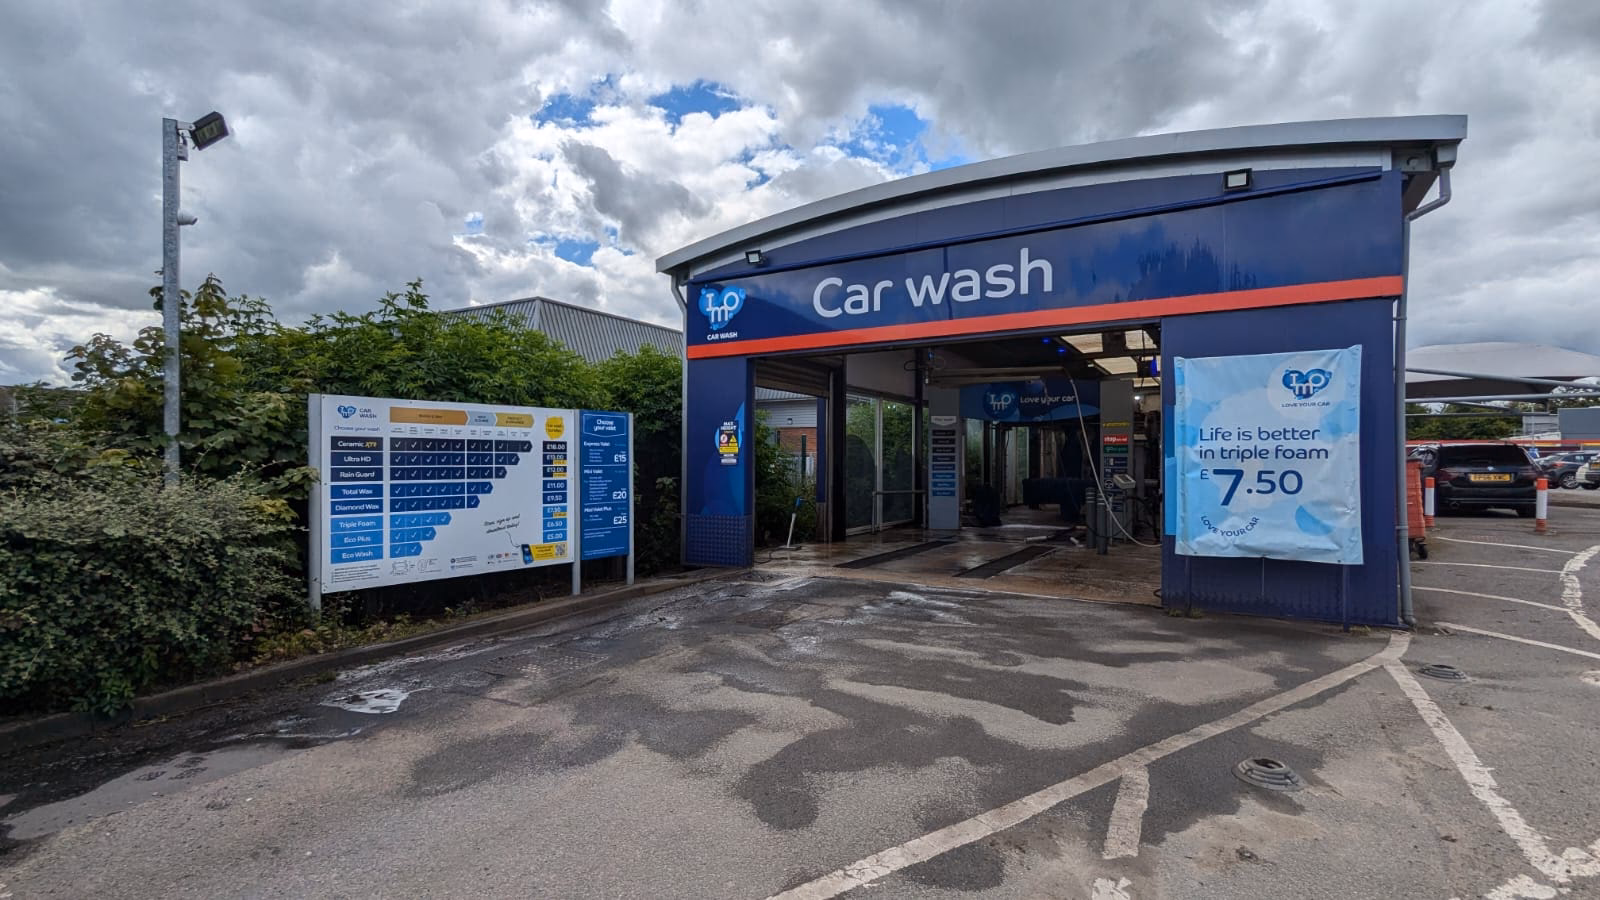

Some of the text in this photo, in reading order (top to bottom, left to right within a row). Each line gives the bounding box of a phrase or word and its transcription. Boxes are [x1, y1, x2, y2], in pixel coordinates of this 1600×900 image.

[813, 247, 1053, 318] Car wash
[707, 331, 738, 341] CAR WASH
[1041, 395, 1060, 404] your
[1199, 426, 1320, 442] Life is better
[614, 454, 627, 462] £15
[1199, 445, 1328, 463] in triple foam
[612, 491, 627, 500] £20
[613, 516, 627, 524] £25
[1200, 515, 1260, 537] LOVE YOUR CAR
